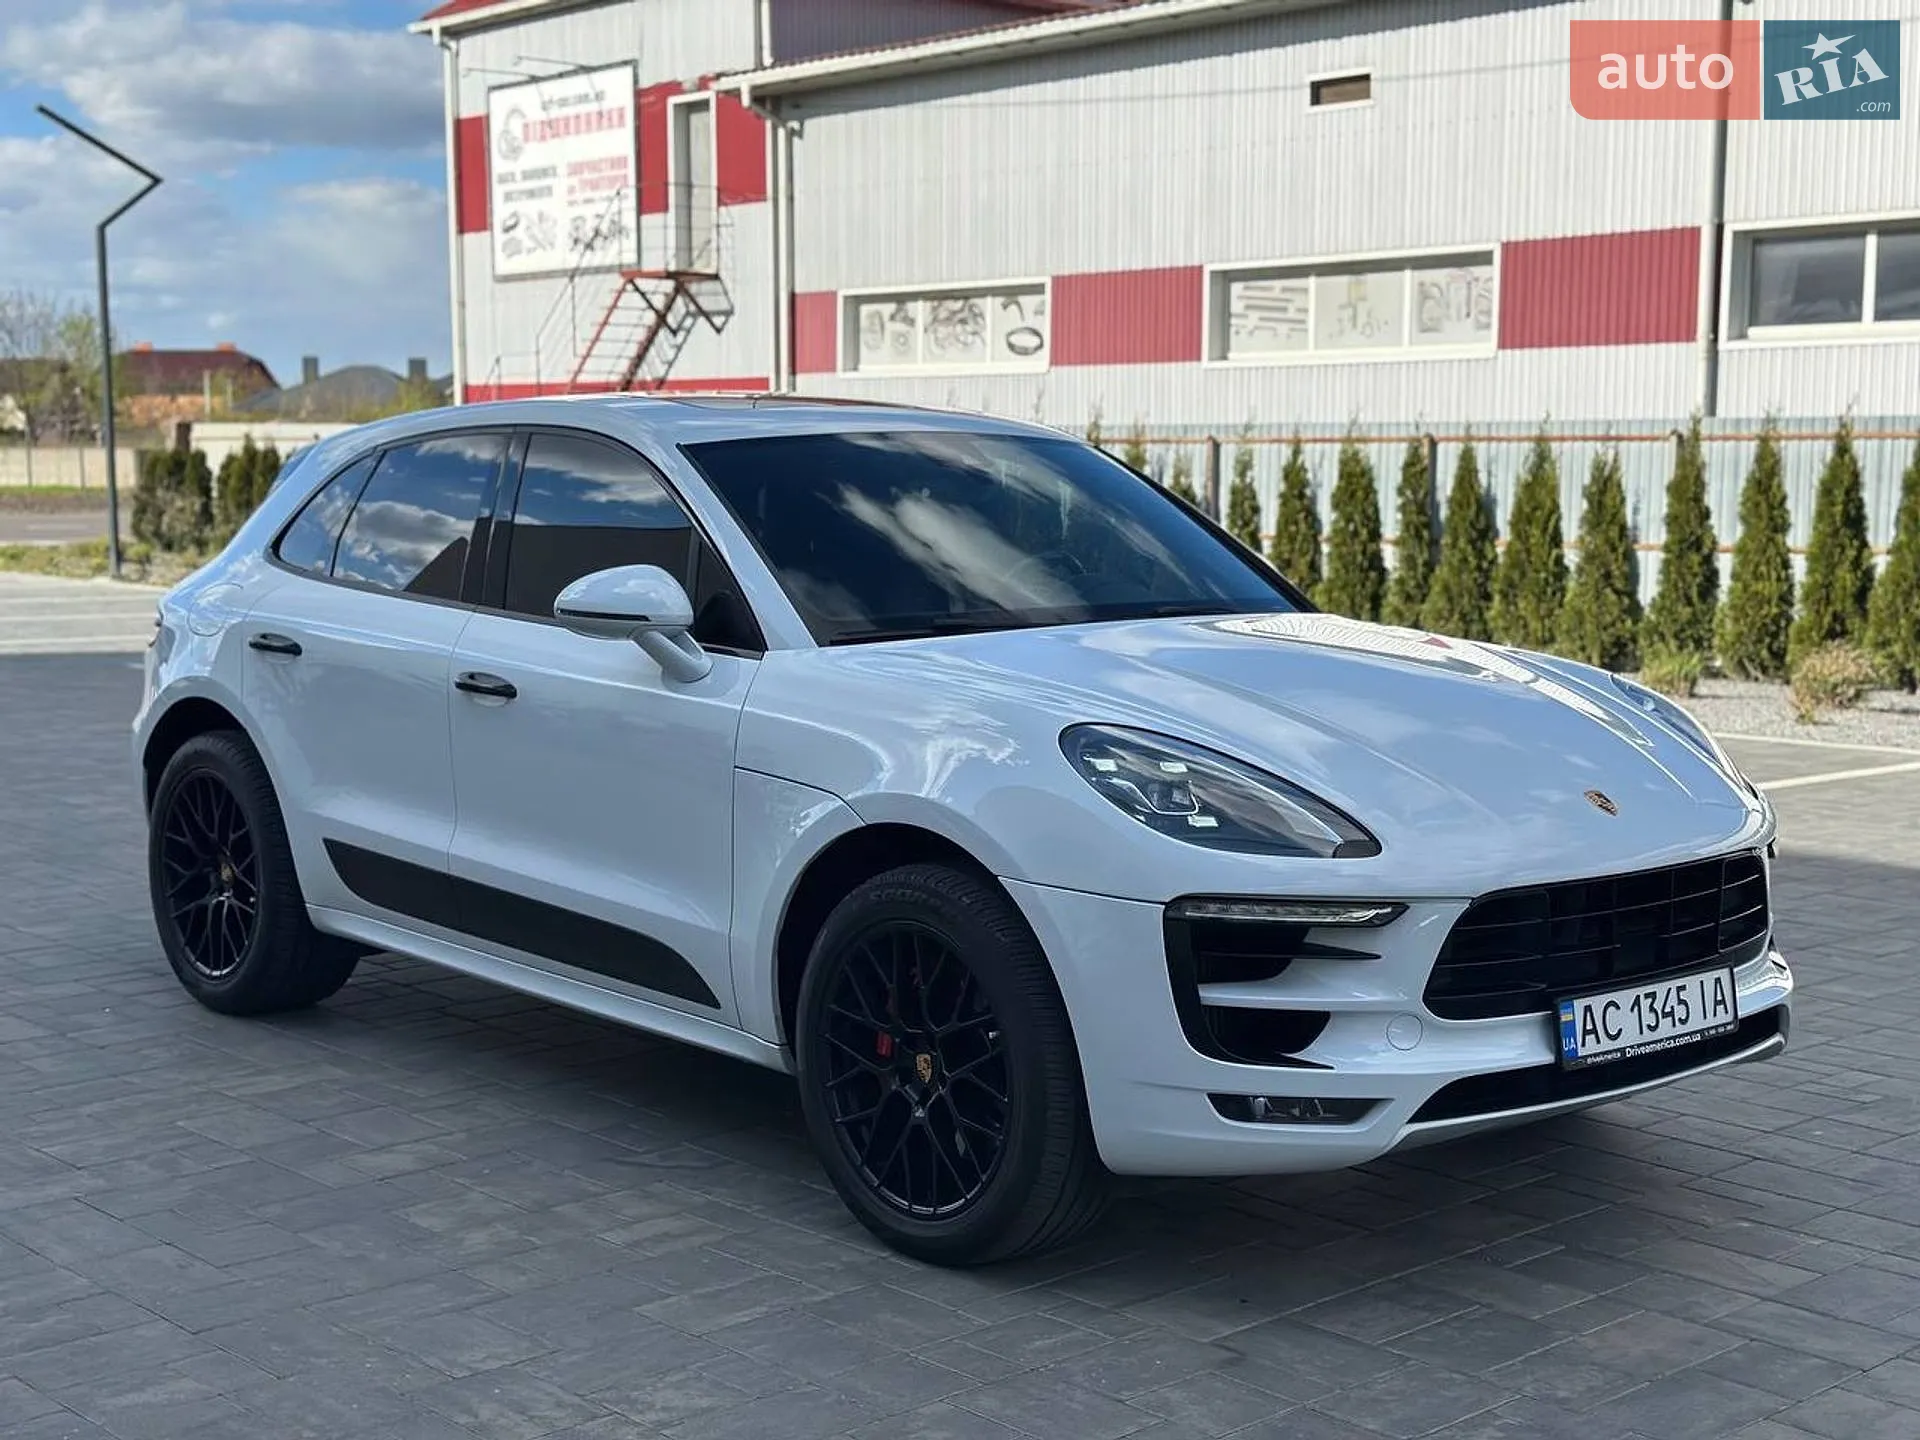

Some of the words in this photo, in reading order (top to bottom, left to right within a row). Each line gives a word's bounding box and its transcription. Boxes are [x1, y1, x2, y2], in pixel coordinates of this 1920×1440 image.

[1581, 1000, 1623, 1048] AC
[1630, 984, 1691, 1035] 1345
[1700, 976, 1729, 1020] IA
[1562, 1037, 1577, 1051] UA
[1625, 1033, 1701, 1058] Driveamerica.com.ua
